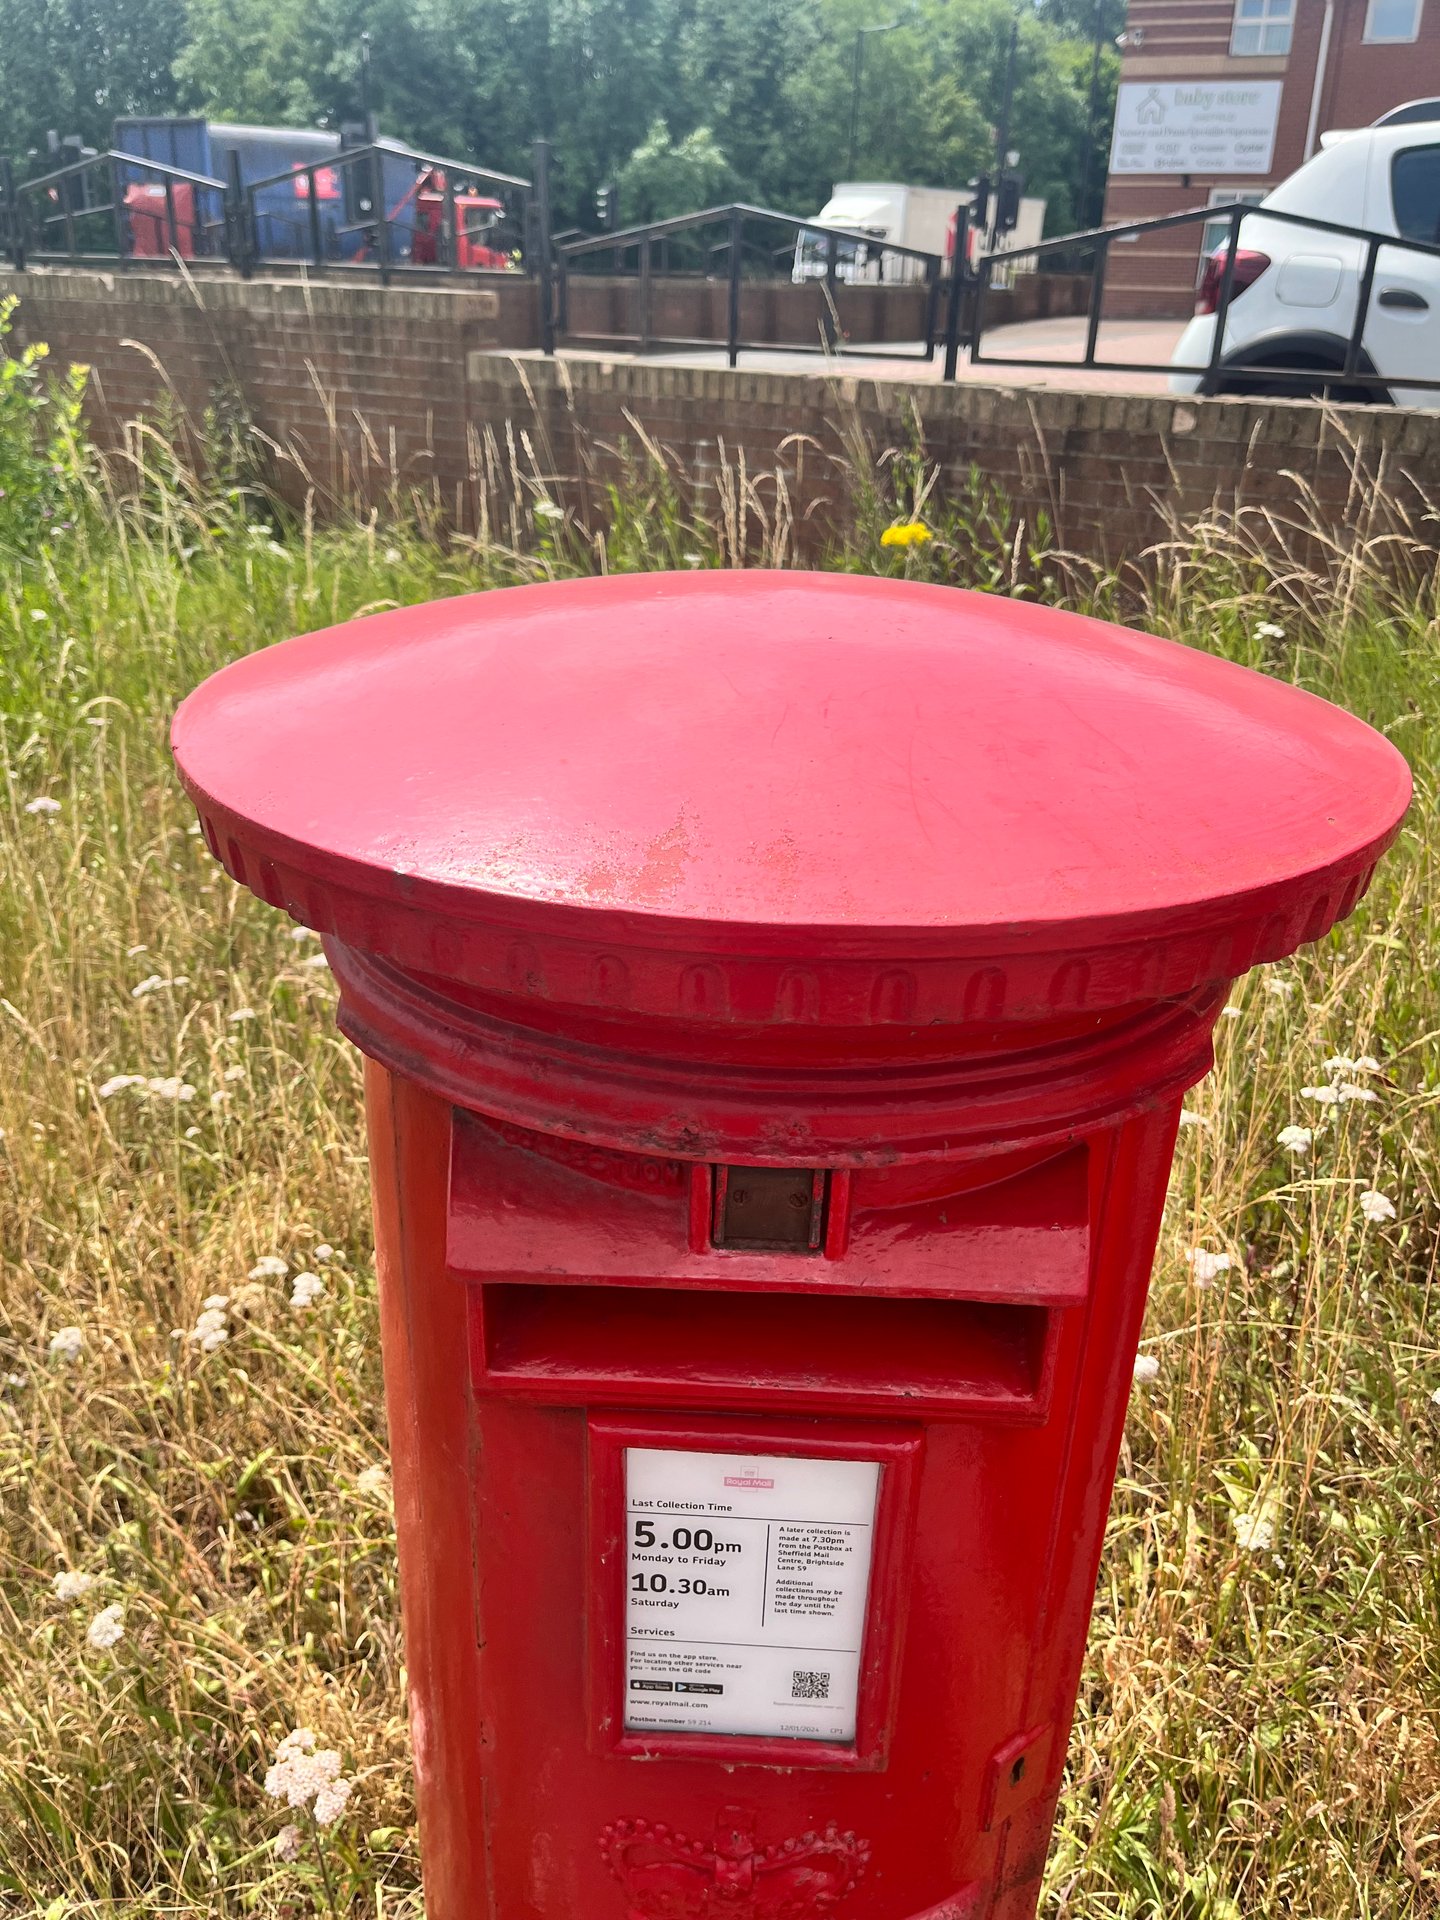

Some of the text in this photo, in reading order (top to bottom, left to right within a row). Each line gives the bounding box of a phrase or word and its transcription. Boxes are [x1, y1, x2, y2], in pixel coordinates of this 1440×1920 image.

[1174, 87, 1261, 110] baby store
[632, 1499, 733, 1511] Last Collection Time
[634, 1520, 742, 1554] 5.00pm
[812, 1536, 844, 1544] 7.30pm
[632, 1553, 674, 1564] Monday
[692, 1556, 726, 1567] Friday
[631, 1573, 730, 1596] 10.30am
[631, 1598, 679, 1609] Saturday
[630, 1627, 675, 1636] Services
[630, 1700, 708, 1708] www.royalmail.com
